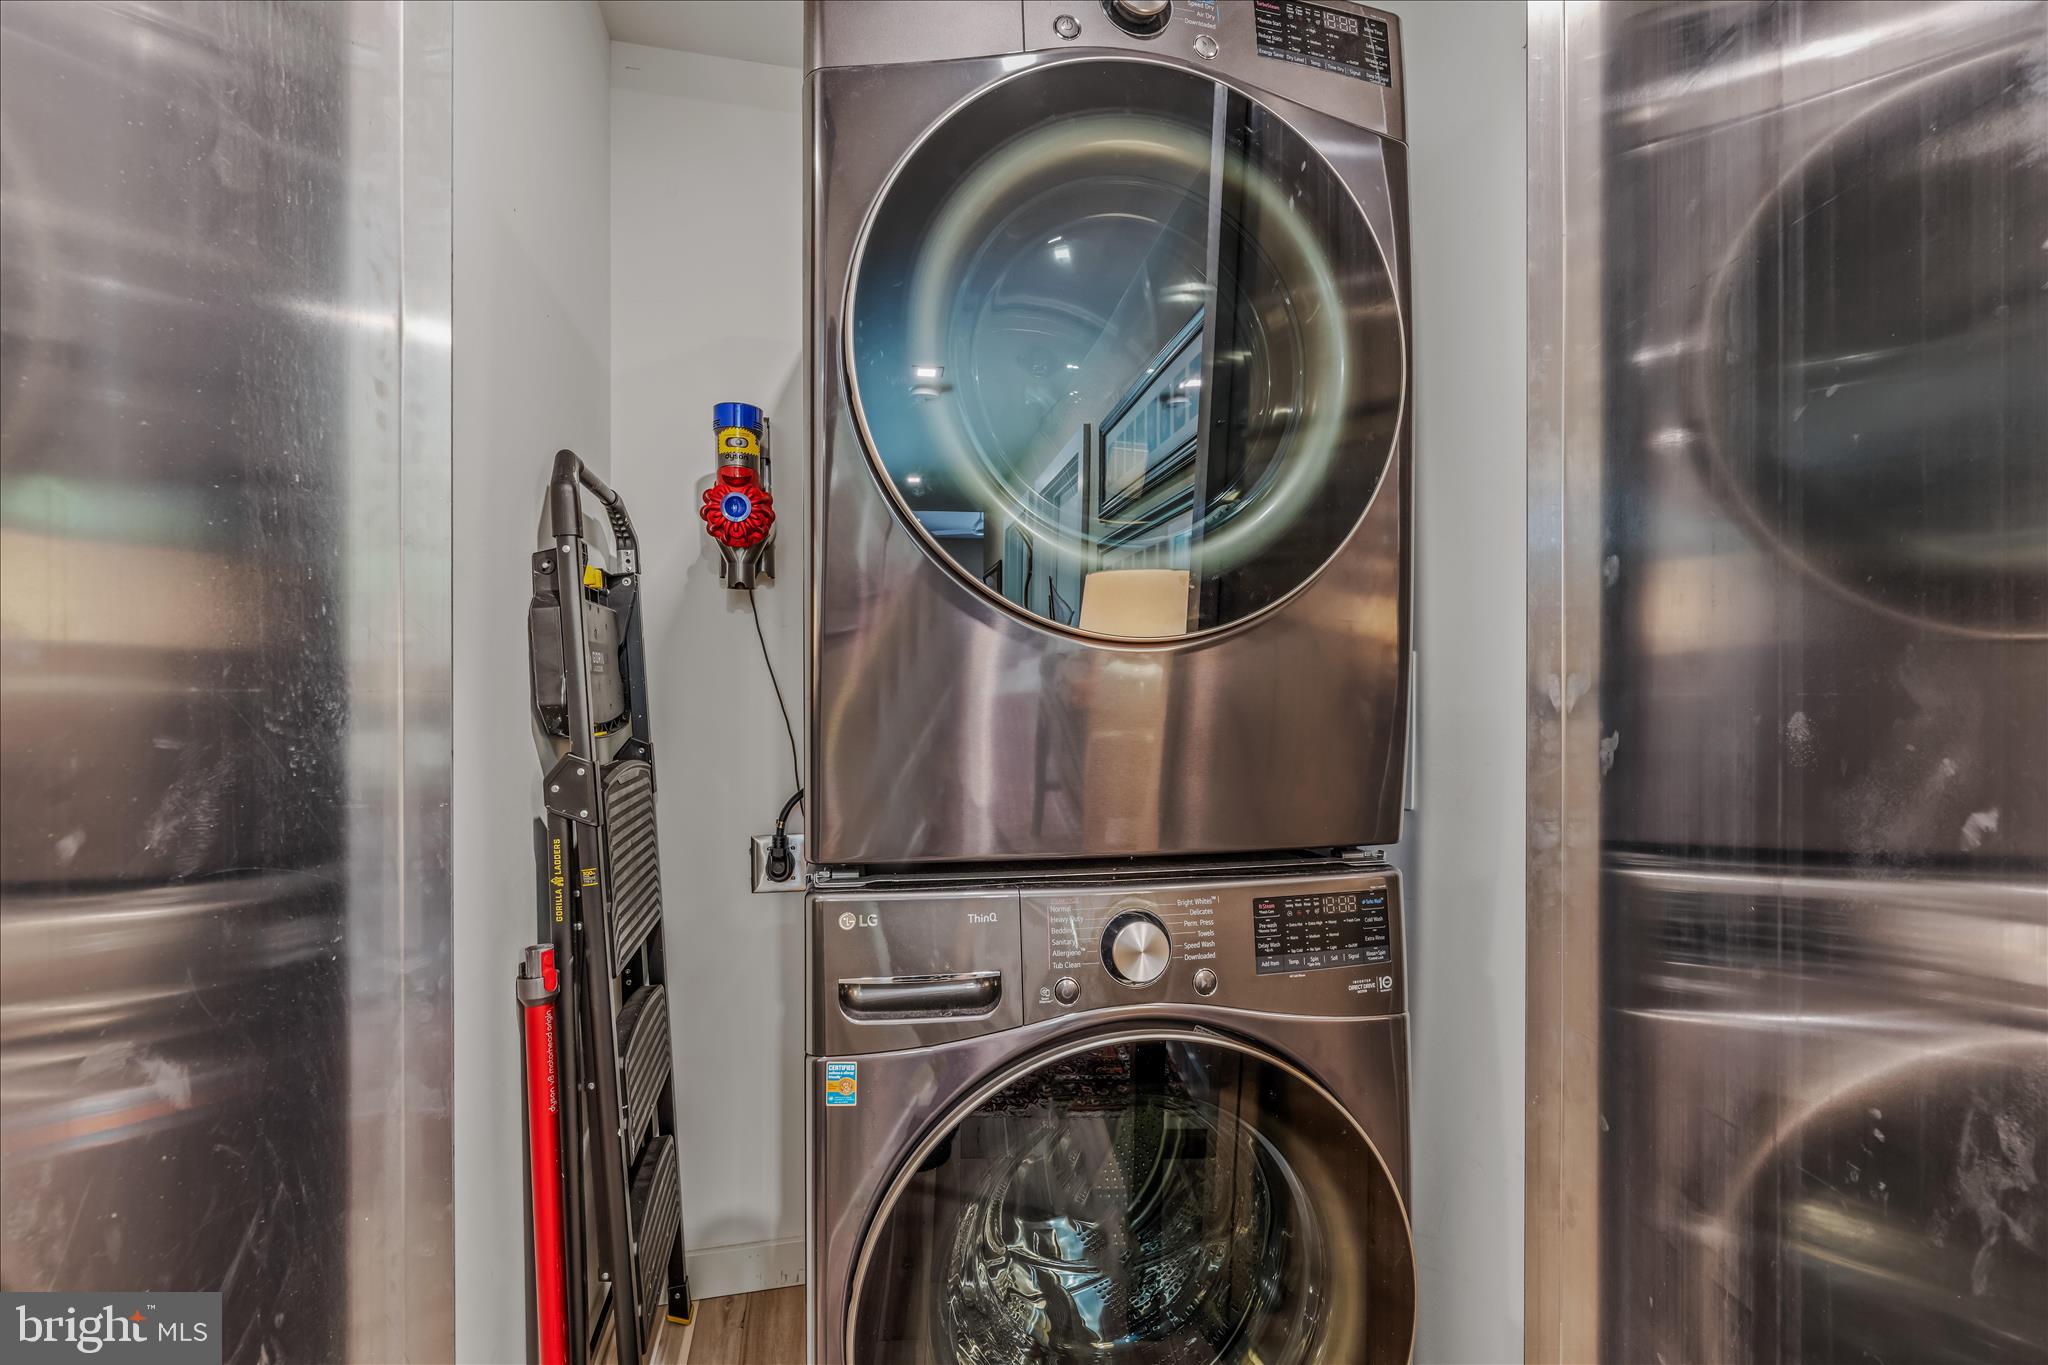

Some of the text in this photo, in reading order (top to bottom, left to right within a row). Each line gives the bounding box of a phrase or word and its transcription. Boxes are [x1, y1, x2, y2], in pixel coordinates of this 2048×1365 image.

[1205, 4, 1214, 12] Dry
[1205, 13, 1216, 21] Dry
[1184, 17, 1216, 30] Downloaded
[725, 453, 749, 461] dyson
[553, 838, 562, 875] LADDERS
[555, 888, 564, 922] GORILLA
[1177, 899, 1194, 907] Bright
[1050, 905, 1072, 913] Normal
[1189, 908, 1214, 916] Delicates
[858, 913, 878, 928] LG
[967, 912, 998, 925] ThinQ
[1050, 916, 1068, 924] Heavy
[1199, 918, 1214, 926] Press
[1197, 929, 1215, 937] Towels
[1052, 938, 1077, 948] Sanitary
[1183, 940, 1216, 951] Speed Wash
[1184, 951, 1216, 961] Downloaded
[1053, 960, 1081, 969] Tub Clean
[1362, 982, 1376, 990] DRIVE
[544, 1008, 553, 1031] origin
[545, 1031, 554, 1074] motorhead
[548, 1087, 558, 1112] dyson
